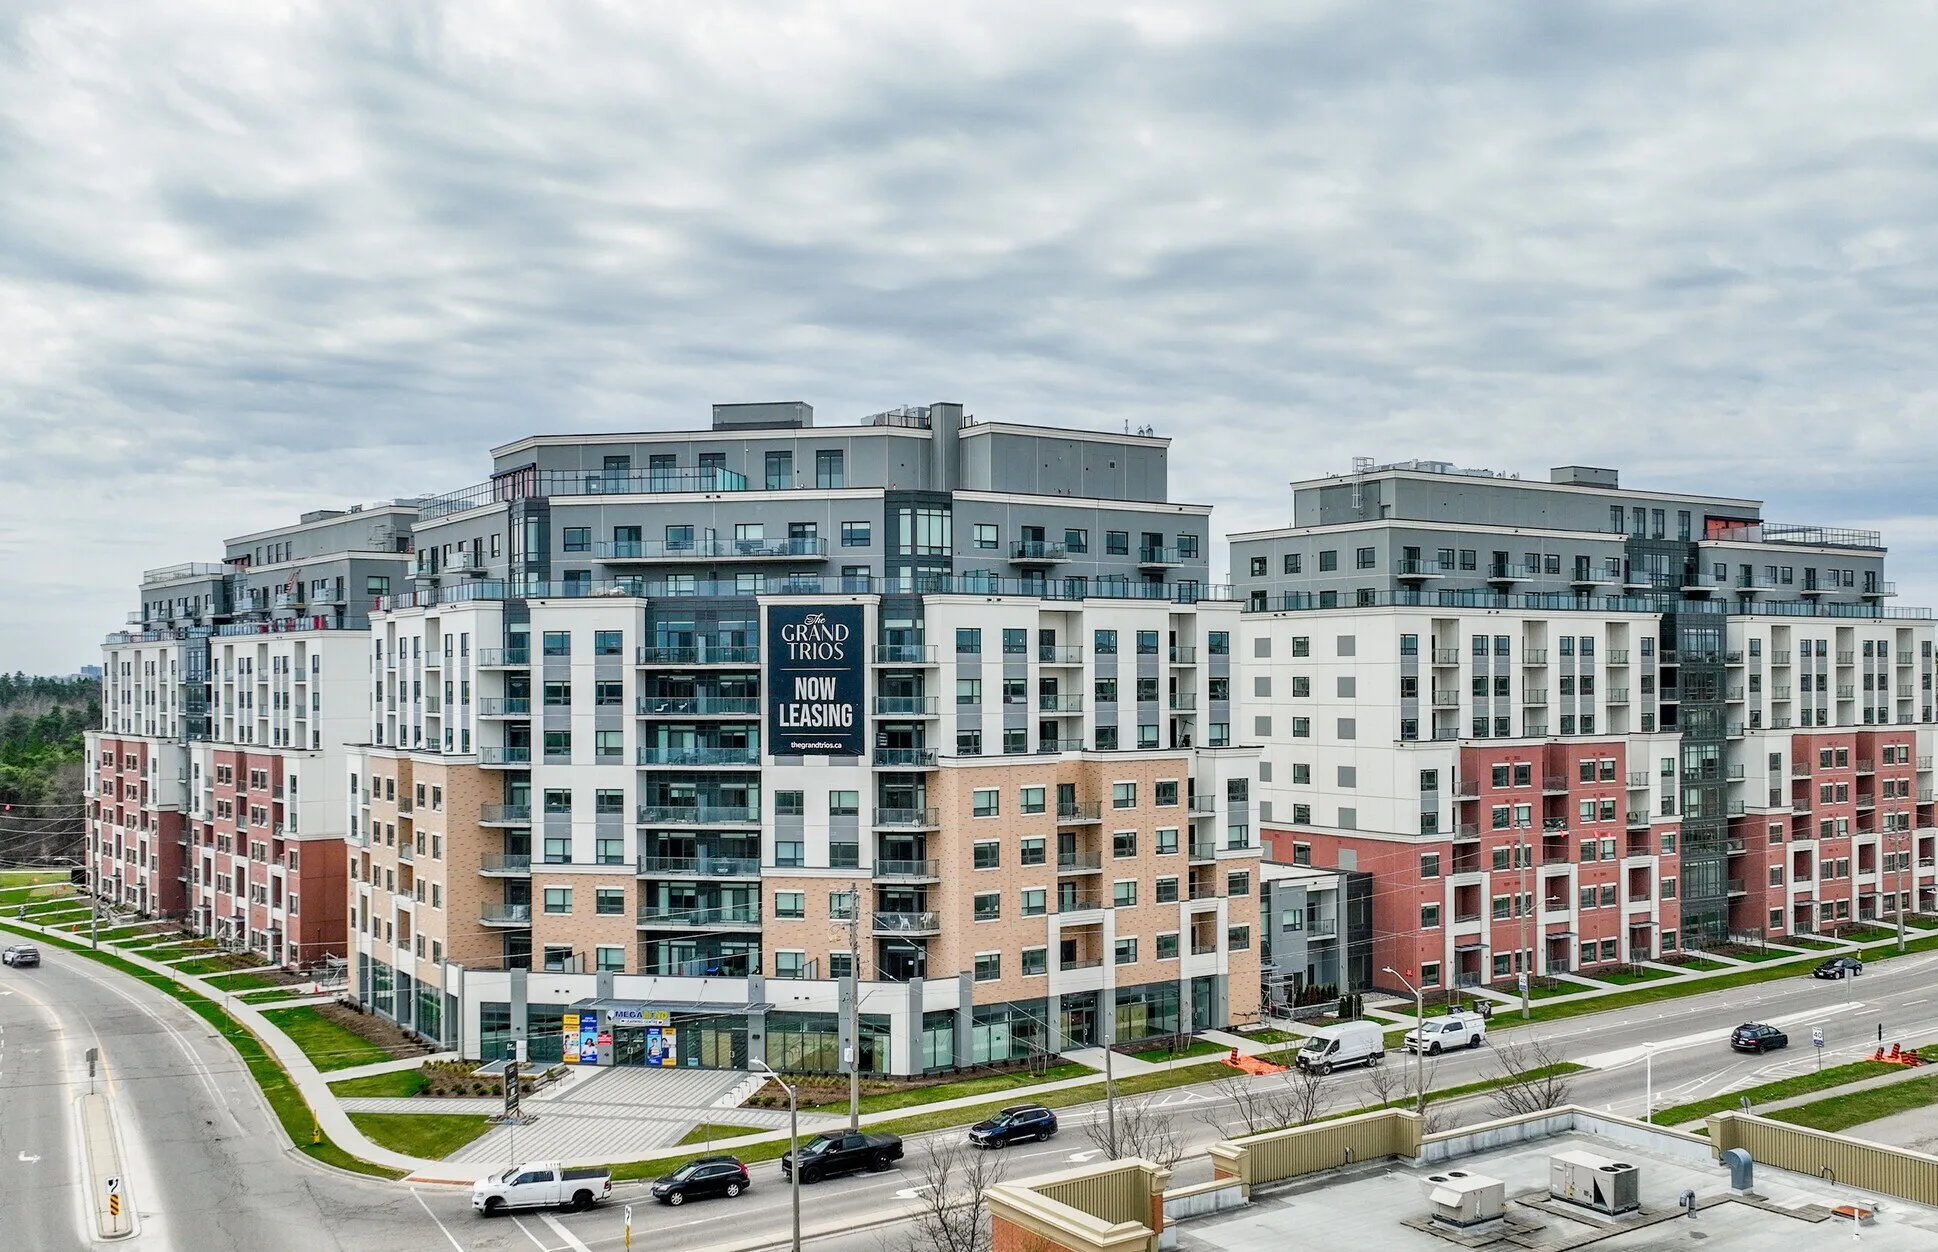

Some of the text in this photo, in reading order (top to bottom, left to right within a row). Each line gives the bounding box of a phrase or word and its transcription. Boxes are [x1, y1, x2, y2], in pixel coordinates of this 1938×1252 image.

[804, 612, 826, 625] The
[781, 623, 850, 642] GRAND
[787, 642, 844, 660] TRIOS
[795, 677, 837, 700] NOW
[779, 703, 853, 727] LEASING
[790, 741, 842, 750] thegrandtrios.ca
